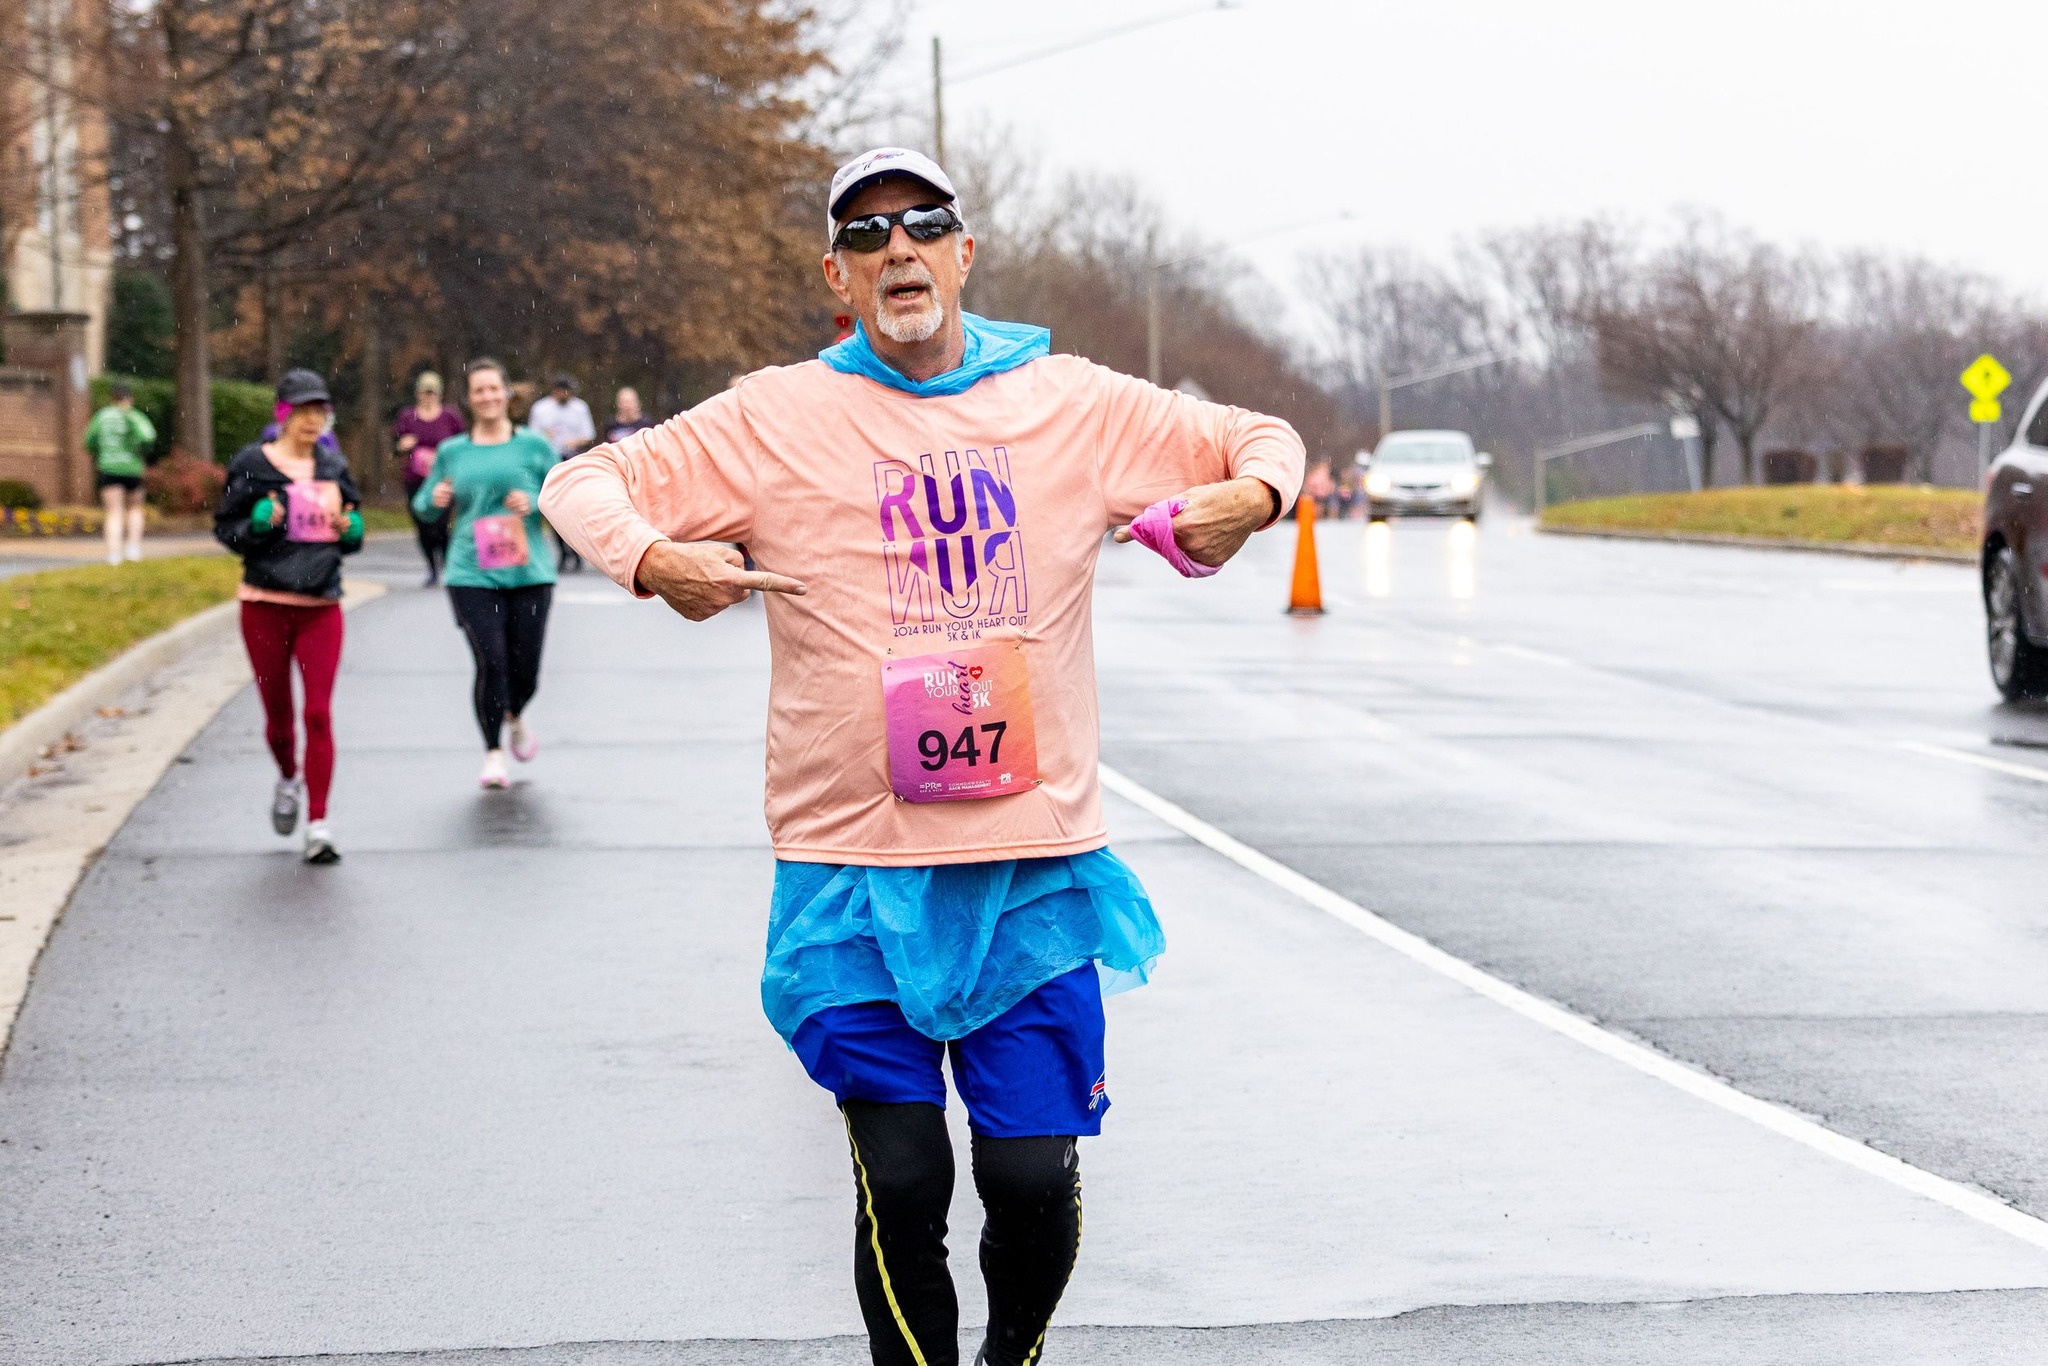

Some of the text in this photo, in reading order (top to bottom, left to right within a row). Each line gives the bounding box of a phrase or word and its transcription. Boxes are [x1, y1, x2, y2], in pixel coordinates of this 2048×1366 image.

[873, 447, 1019, 541] RUN
[893, 615, 1028, 637] 2024 RUN YOUR HEART OUT
[947, 631, 958, 642] 5K
[961, 631, 969, 640] &
[923, 669, 959, 688] RUN
[947, 661, 973, 715] heart
[925, 680, 993, 699] YOUR OUT
[972, 691, 992, 709] 5K
[917, 720, 1007, 772] 947
